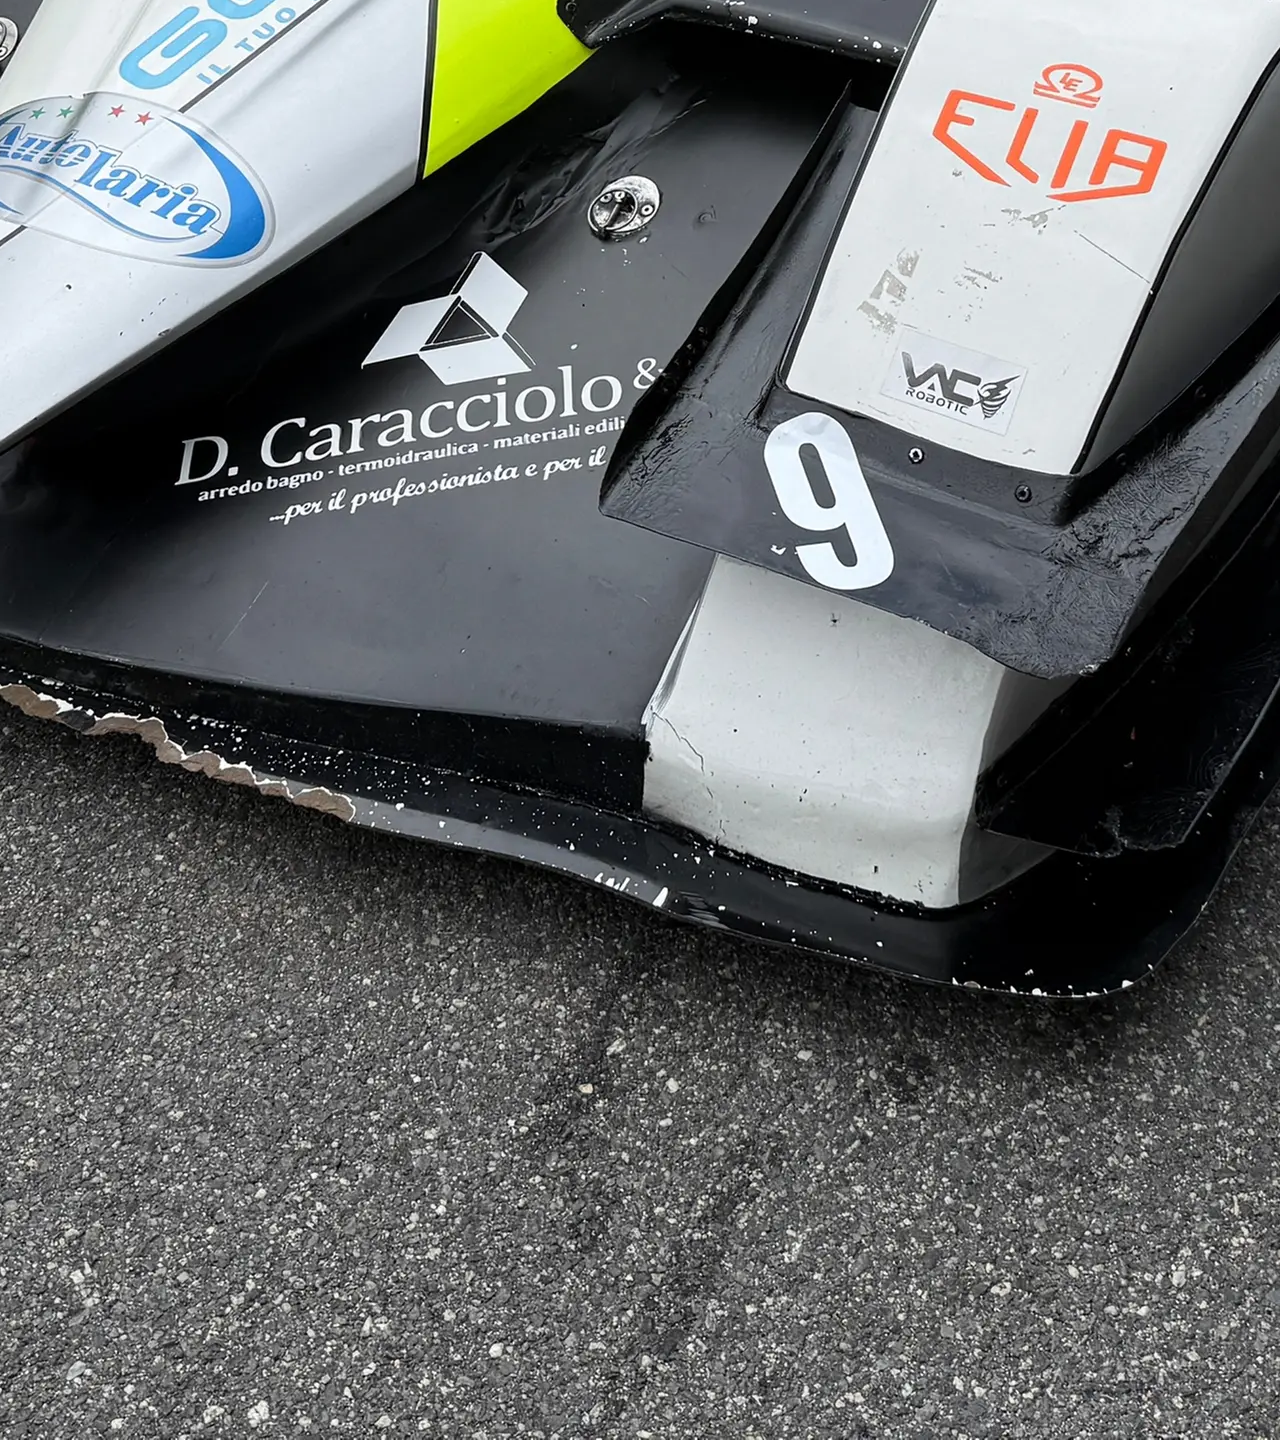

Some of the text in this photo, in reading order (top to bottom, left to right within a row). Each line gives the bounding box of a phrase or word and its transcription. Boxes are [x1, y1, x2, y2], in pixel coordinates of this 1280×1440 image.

[195, 60, 232, 86] IL
[233, 6, 298, 53] TUO
[931, 88, 1169, 203] ELIA
[173, 357, 666, 486] D. Caracciolo &
[904, 386, 969, 417] ROBOTIC
[197, 478, 264, 502] arredo
[266, 469, 325, 490] bagno
[337, 442, 480, 477] termoidraulica
[493, 423, 581, 450] materiali
[327, 487, 347, 512] il
[349, 464, 521, 515] professionista
[523, 463, 538, 477] e
[542, 456, 583, 481] per
[587, 445, 608, 468] il
[763, 411, 895, 591] 9
